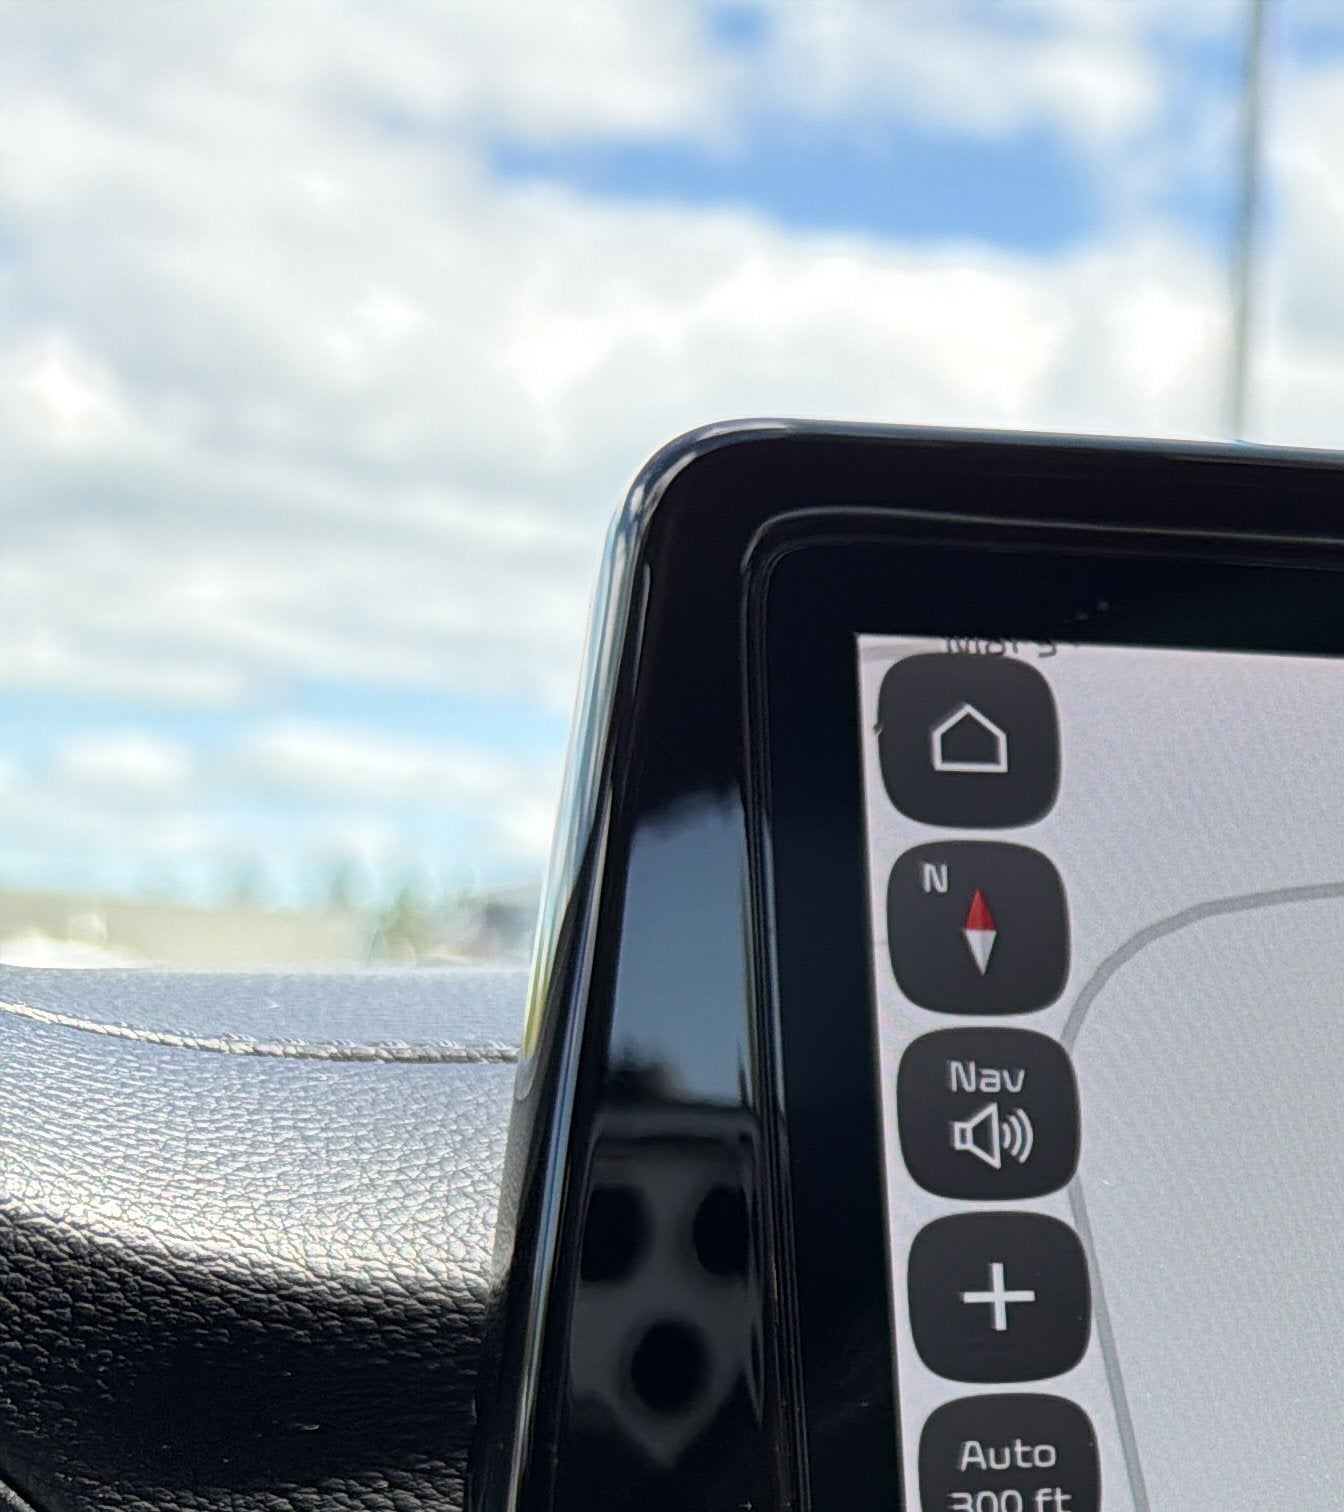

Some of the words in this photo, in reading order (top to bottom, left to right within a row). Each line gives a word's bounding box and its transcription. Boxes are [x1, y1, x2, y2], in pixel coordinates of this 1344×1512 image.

[921, 861, 949, 893] N
[947, 1059, 1026, 1094] Nav
[958, 1439, 1058, 1471] Auto
